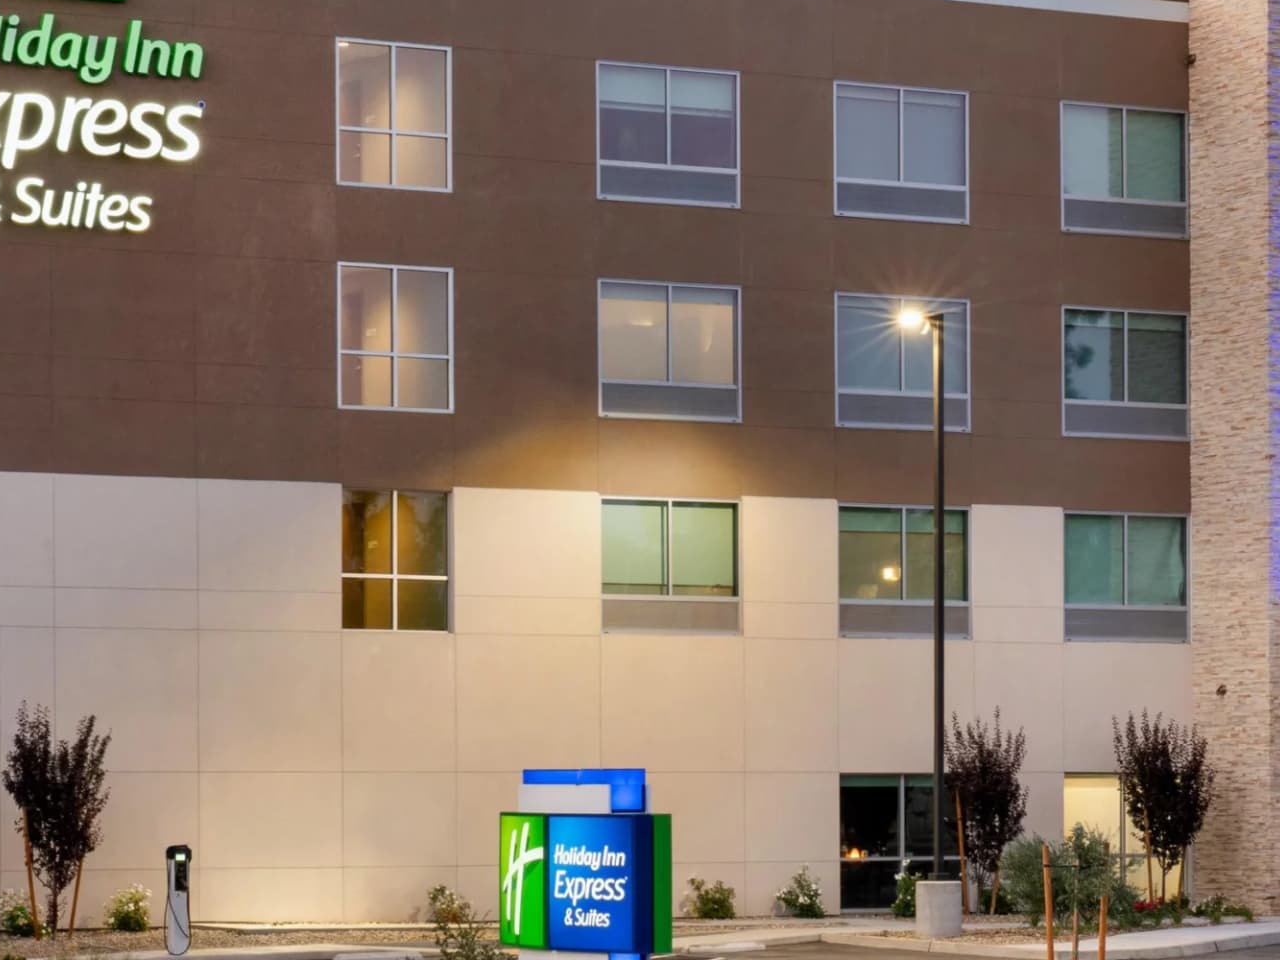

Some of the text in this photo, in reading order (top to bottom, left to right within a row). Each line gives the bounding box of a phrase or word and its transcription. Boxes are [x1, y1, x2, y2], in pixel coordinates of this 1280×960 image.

[124, 20, 204, 79] Inn
[11, 177, 153, 231] Suites
[553, 844, 626, 871] Holiday Inn
[553, 870, 626, 906] Express
[563, 908, 610, 927] & Suites
